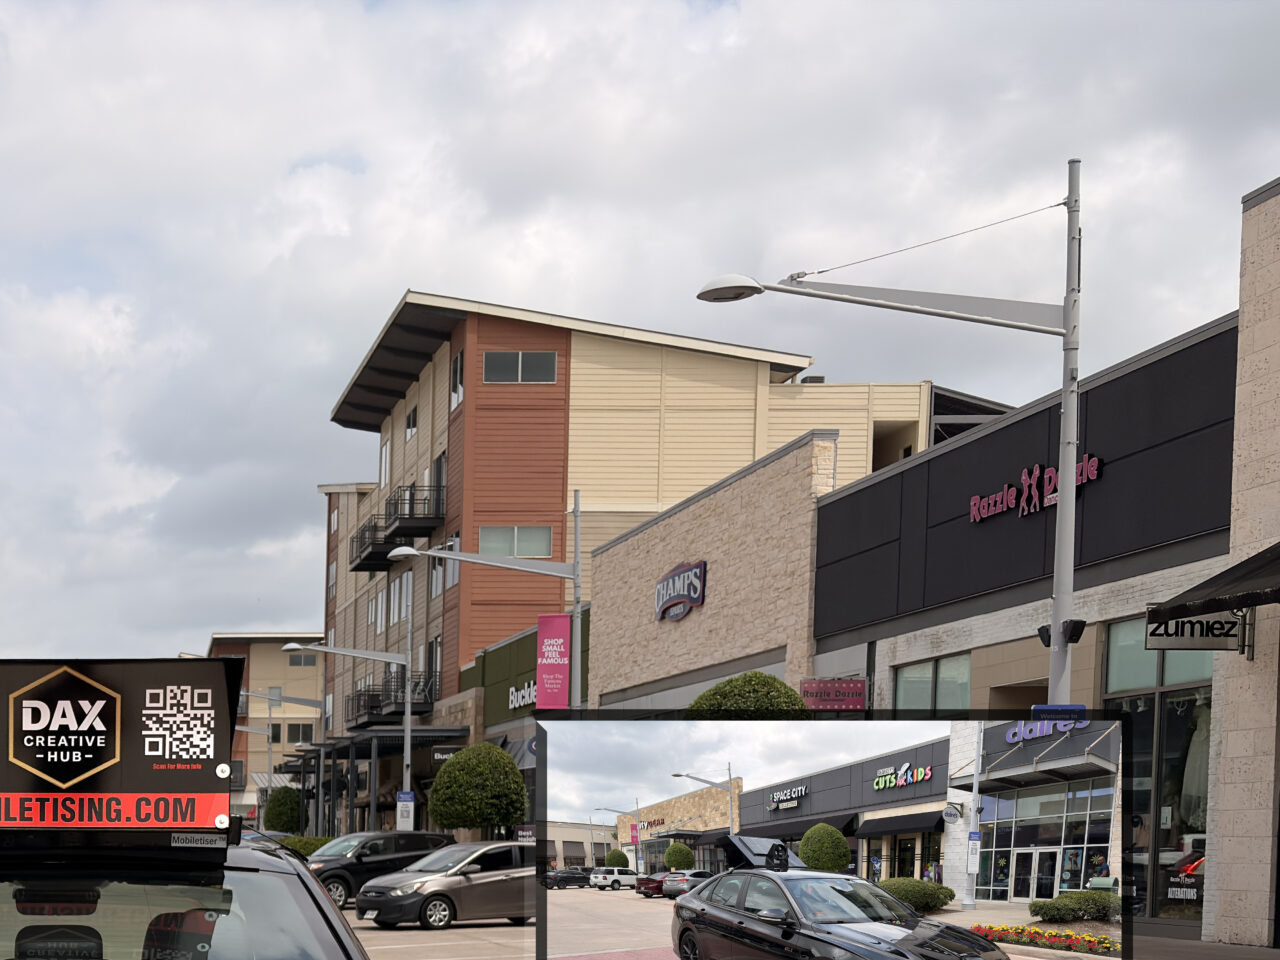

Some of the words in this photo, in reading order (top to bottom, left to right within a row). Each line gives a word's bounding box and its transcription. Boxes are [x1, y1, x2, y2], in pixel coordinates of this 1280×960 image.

[970, 483, 1017, 523] Razzle
[1043, 453, 1099, 496] Dzle
[656, 568, 701, 612] CHAMPS
[537, 657, 569, 665] FAMOUS
[22, 700, 108, 732] DAX
[23, 735, 106, 747] CREATIVE
[873, 774, 896, 790] CUTS
[907, 765, 932, 785] KIDS
[773, 789, 791, 802] SPACE
[792, 785, 806, 798] CITY
